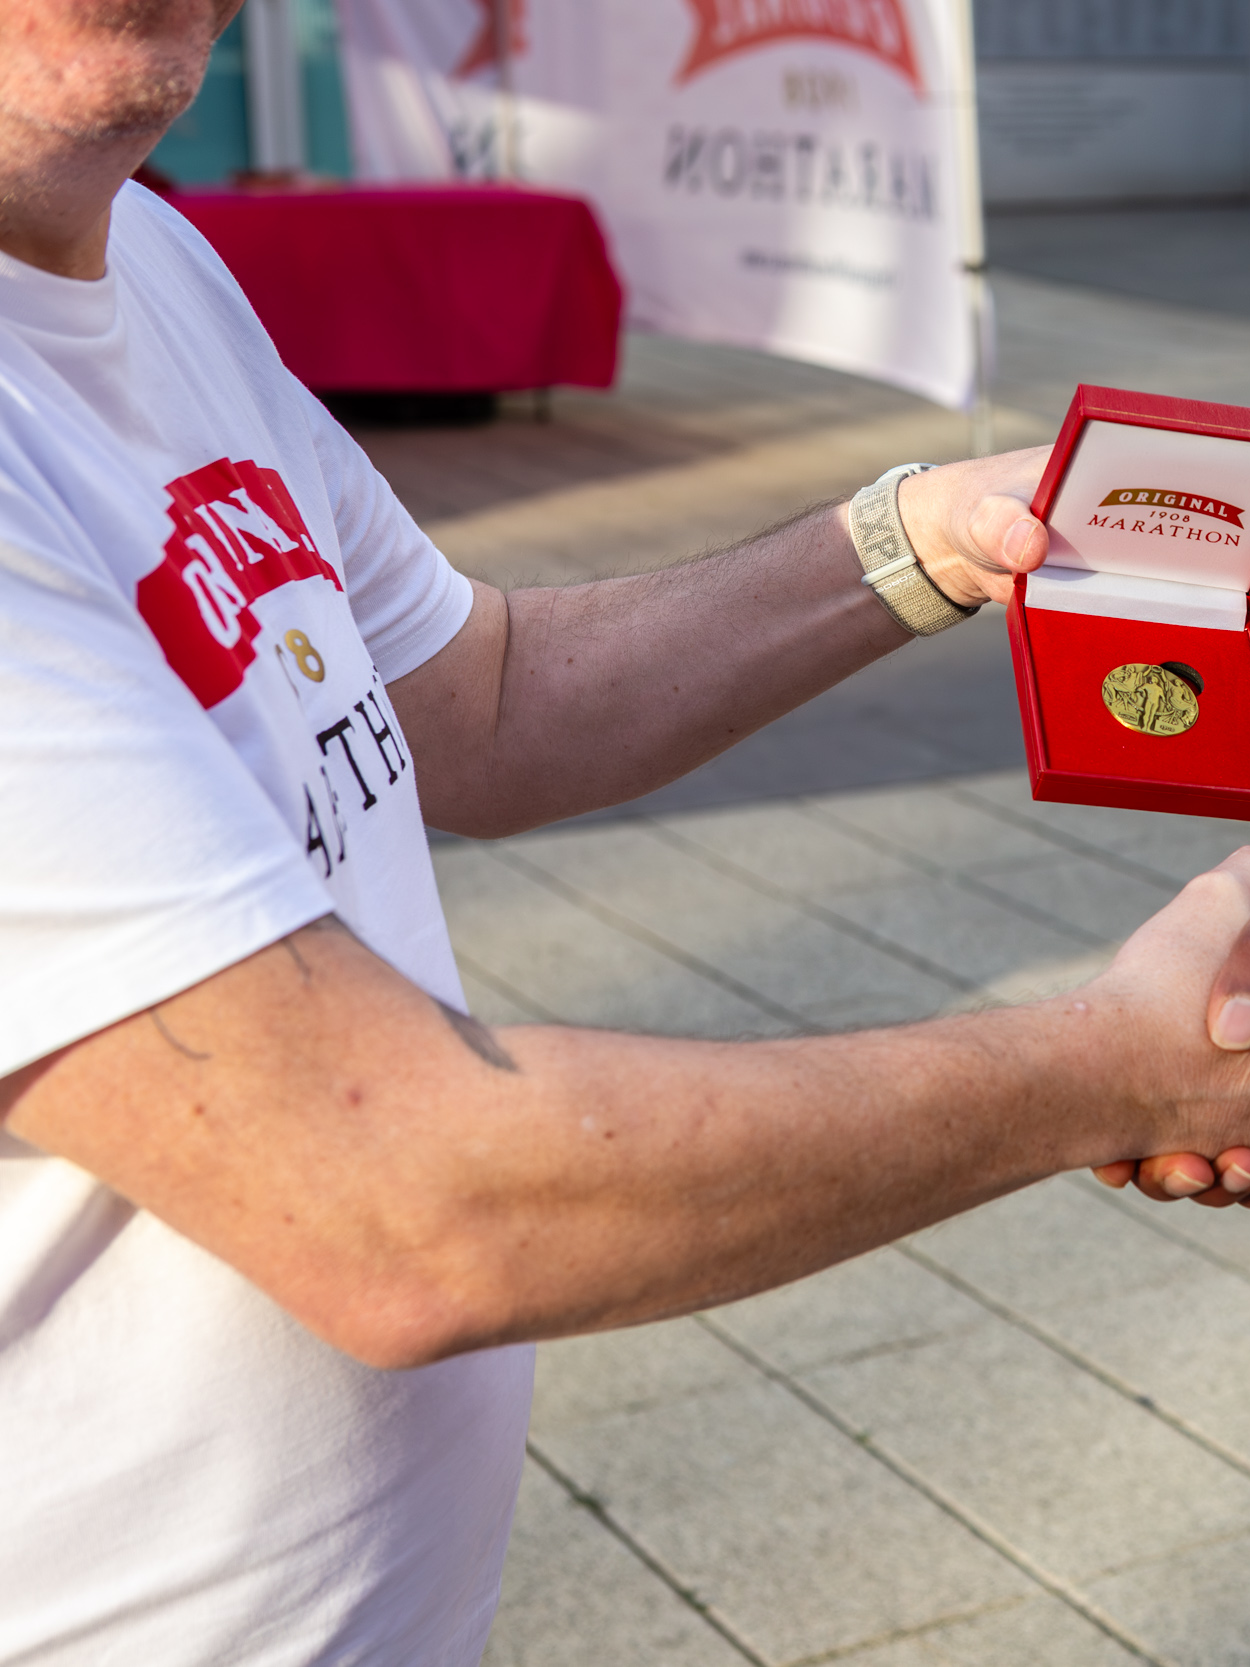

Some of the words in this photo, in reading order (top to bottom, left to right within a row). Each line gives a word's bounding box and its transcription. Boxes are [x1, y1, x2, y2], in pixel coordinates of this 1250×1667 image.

[1118, 491, 1228, 518] ORIGINAL
[1149, 511, 1190, 523] 1908
[1087, 514, 1241, 547] MARATHON
